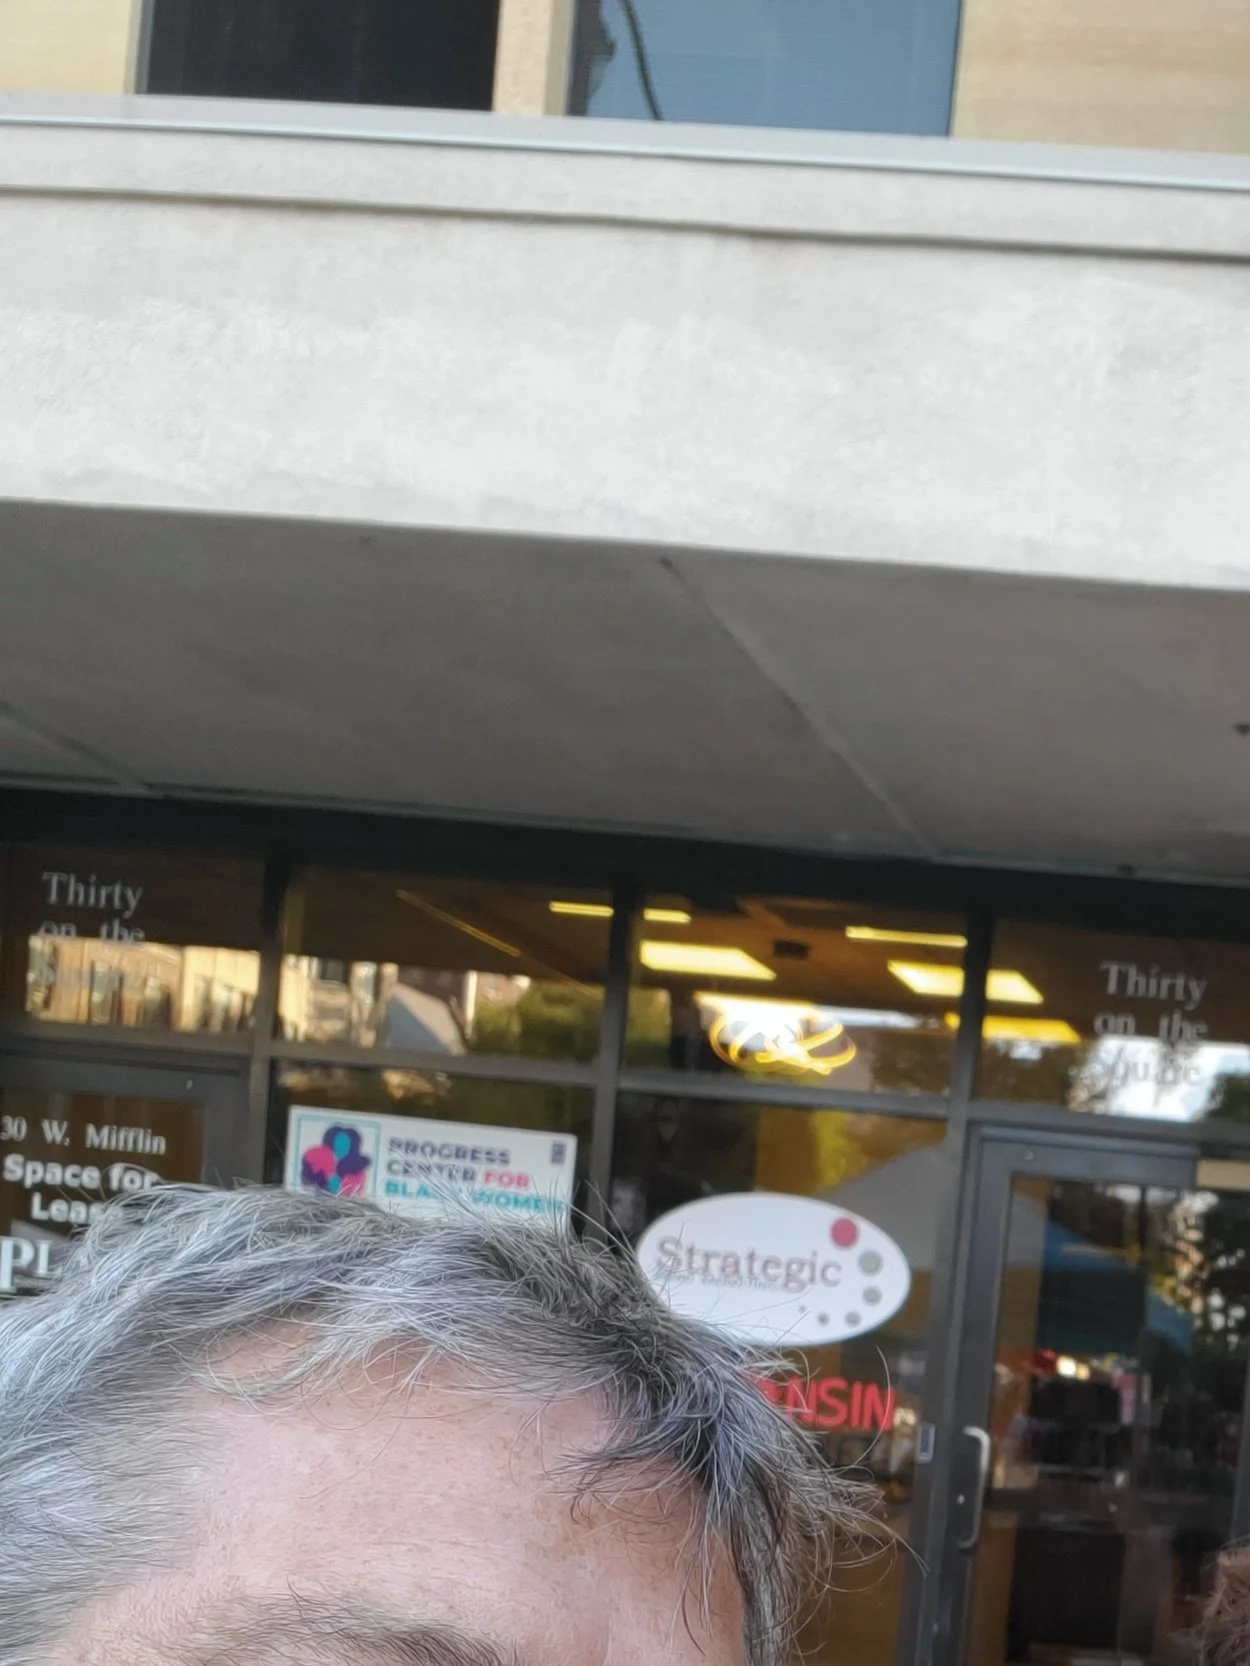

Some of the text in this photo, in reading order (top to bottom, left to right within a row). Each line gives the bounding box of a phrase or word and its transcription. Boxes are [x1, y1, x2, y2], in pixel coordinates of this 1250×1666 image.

[42, 872, 143, 919] Thirty
[1101, 961, 1207, 1010] Thirty
[1158, 1009, 1208, 1045] the
[0, 1115, 166, 1155] 30 W. Mifflin
[389, 1137, 511, 1166] PROGRESS
[3, 1153, 100, 1189] Space
[484, 1169, 530, 1188] FOR
[657, 1236, 843, 1294] Strategic
